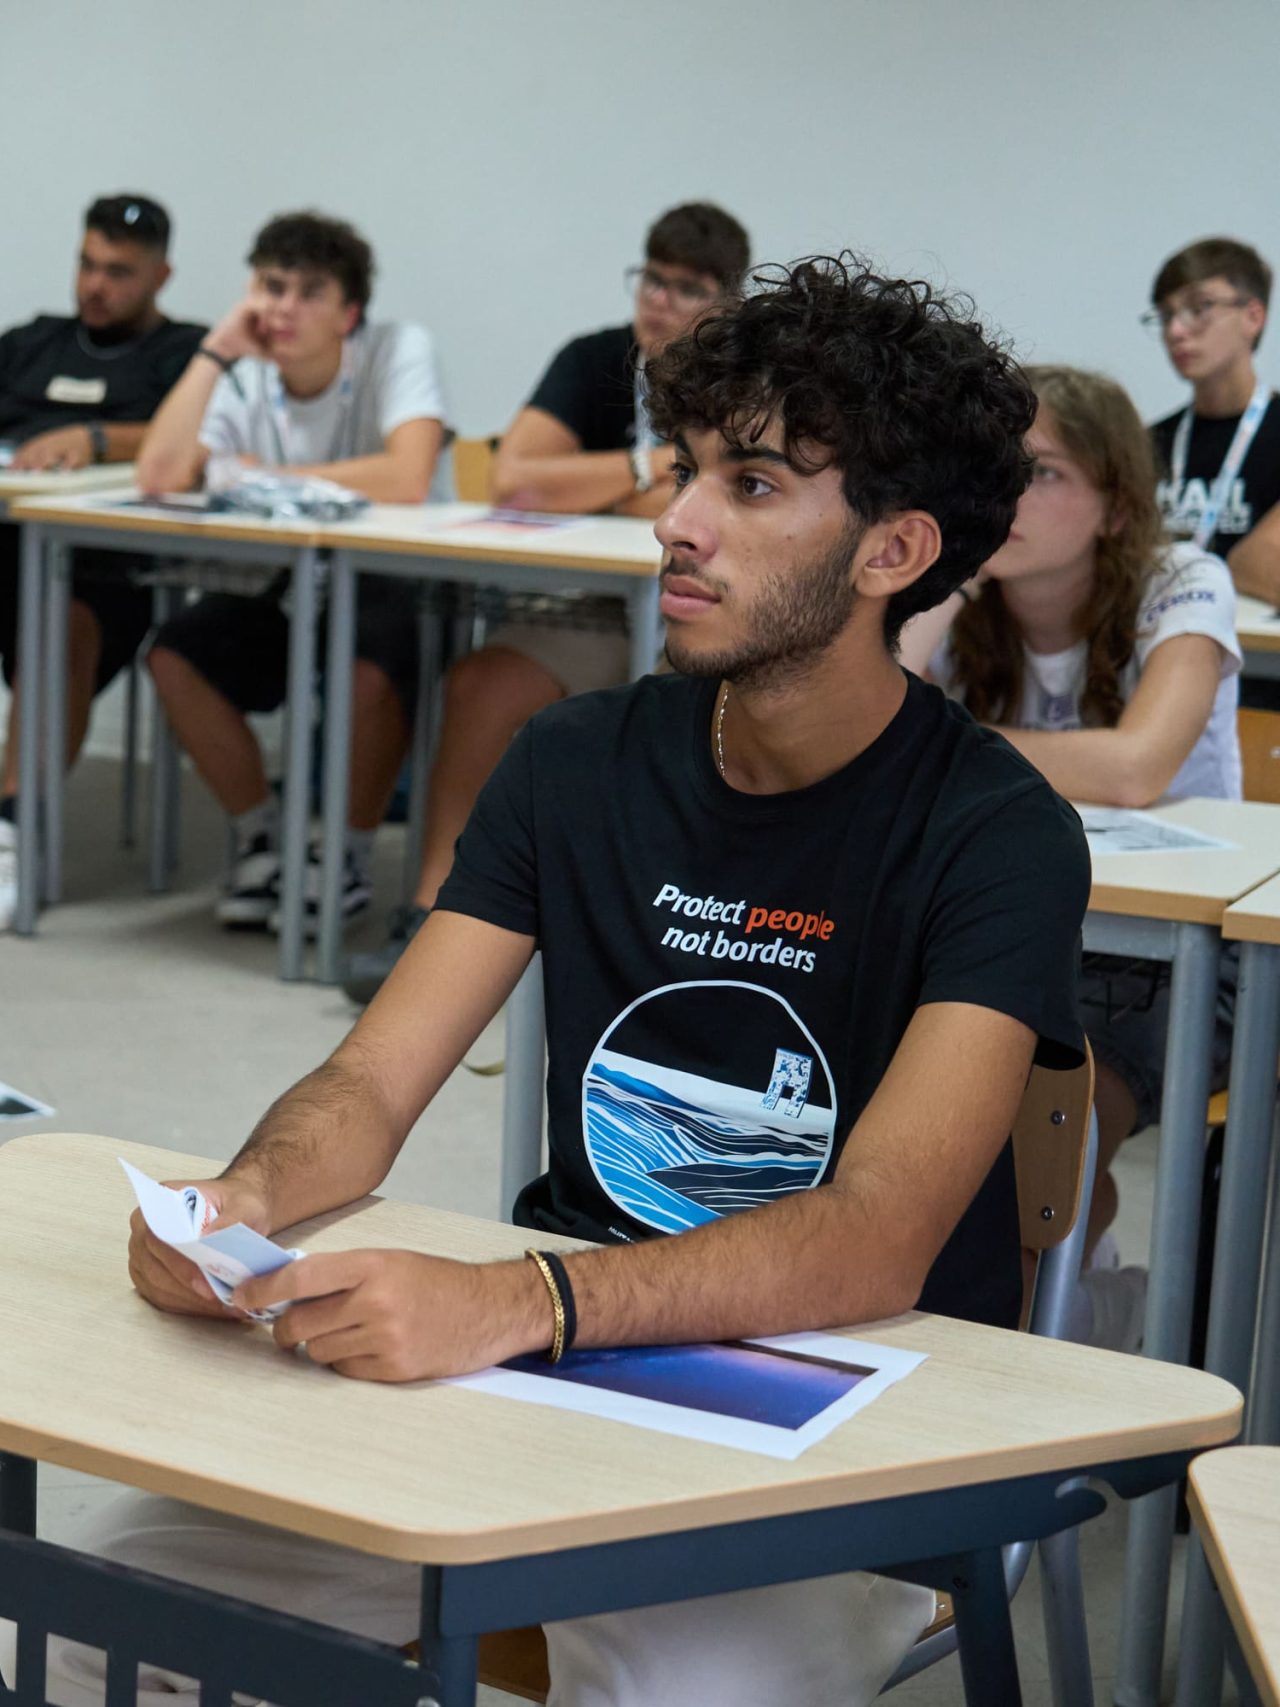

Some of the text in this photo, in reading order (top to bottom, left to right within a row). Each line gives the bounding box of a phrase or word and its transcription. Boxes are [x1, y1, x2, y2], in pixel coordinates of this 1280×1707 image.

[652, 883, 835, 941] Protect people
[660, 926, 817, 973] not borders
